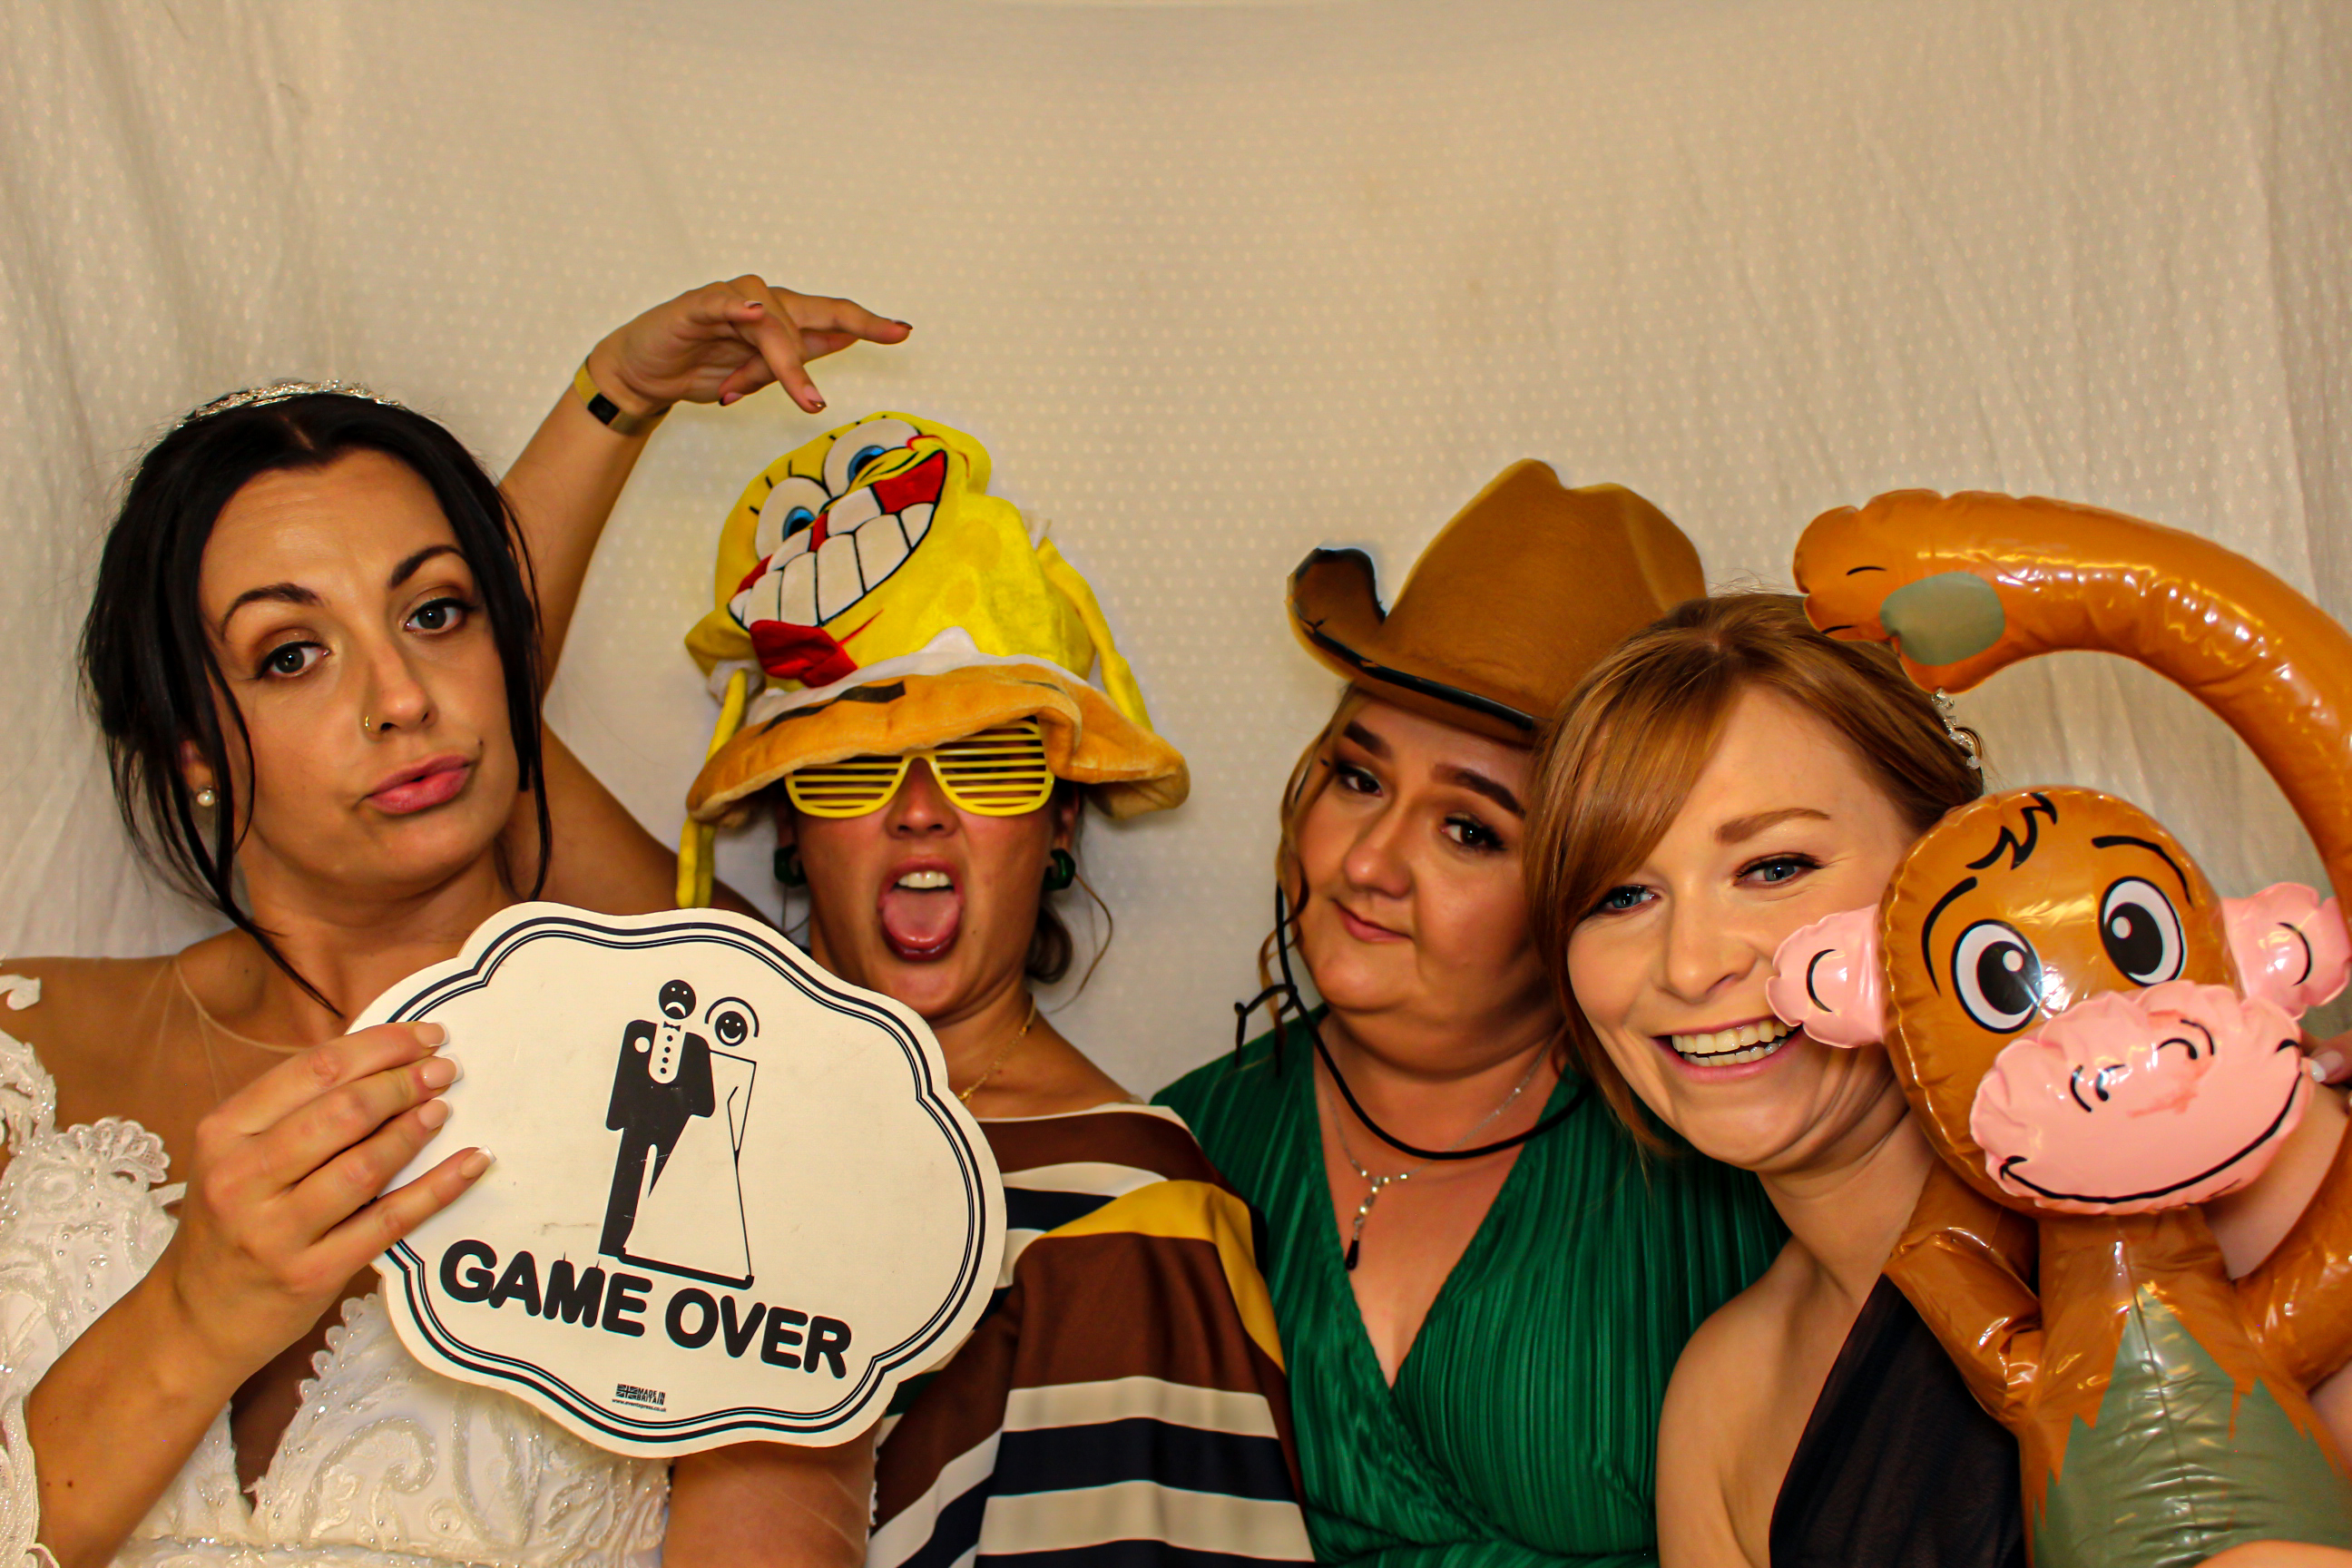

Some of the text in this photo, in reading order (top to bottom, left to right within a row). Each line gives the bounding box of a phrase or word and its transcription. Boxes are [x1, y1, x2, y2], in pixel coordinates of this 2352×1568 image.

[439, 1239, 852, 1379] GAME OVER
[637, 1387, 666, 1399] MADE IN
[636, 1394, 665, 1406] BRITAIN
